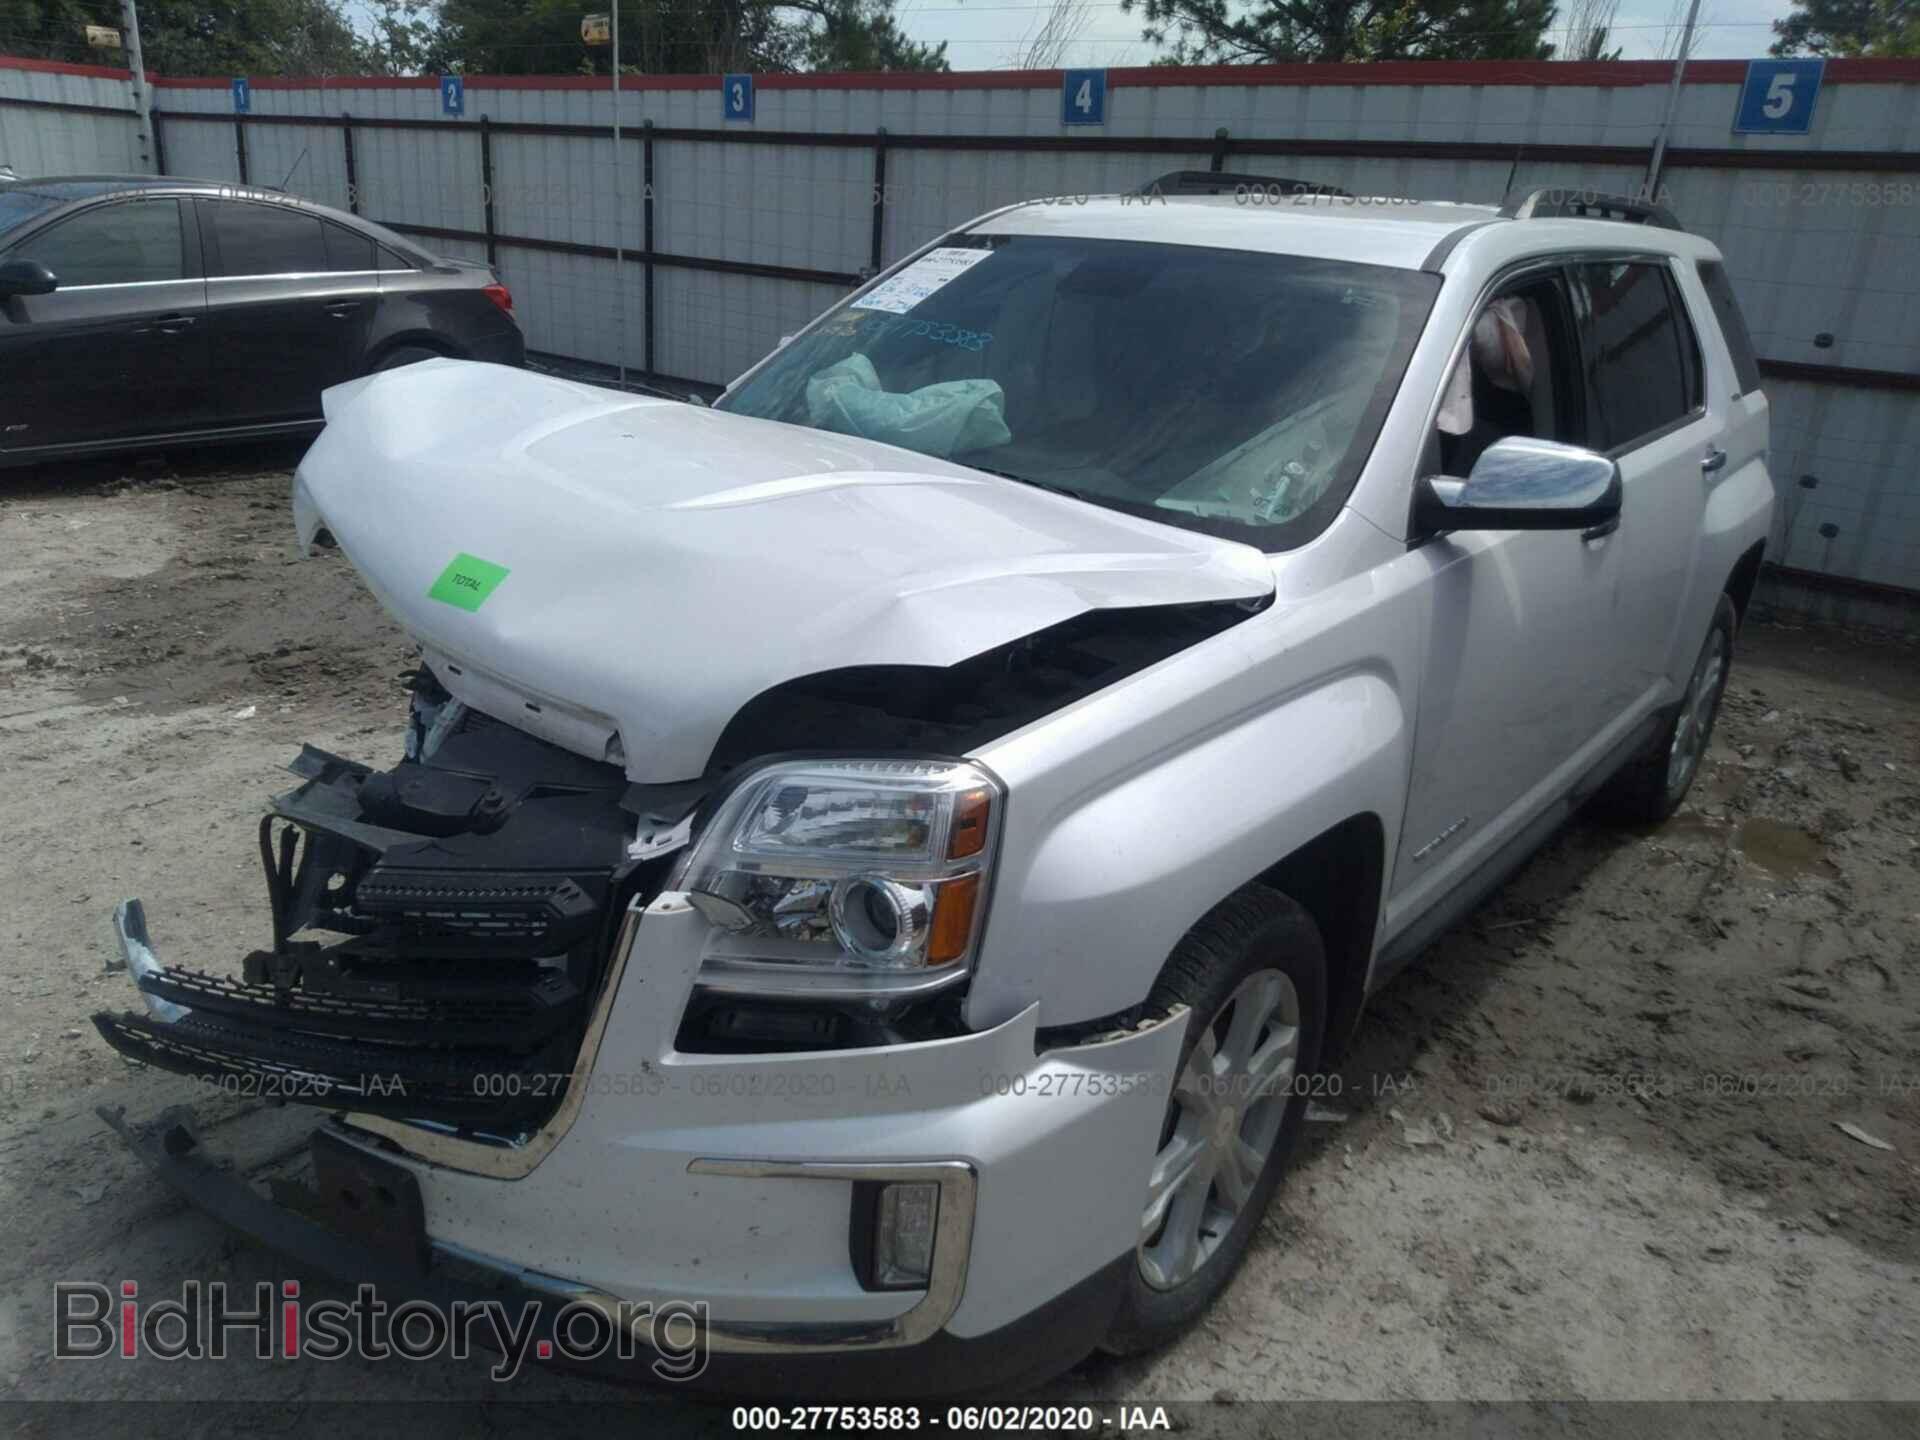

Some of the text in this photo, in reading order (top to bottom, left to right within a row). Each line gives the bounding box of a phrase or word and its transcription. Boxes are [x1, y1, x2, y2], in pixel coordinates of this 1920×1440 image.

[238, 84, 245, 105] 1
[447, 83, 457, 107] 2
[732, 82, 743, 112] 3
[1075, 79, 1092, 113] 4
[1763, 72, 1797, 119] 5
[451, 573, 481, 593] TOTAL
